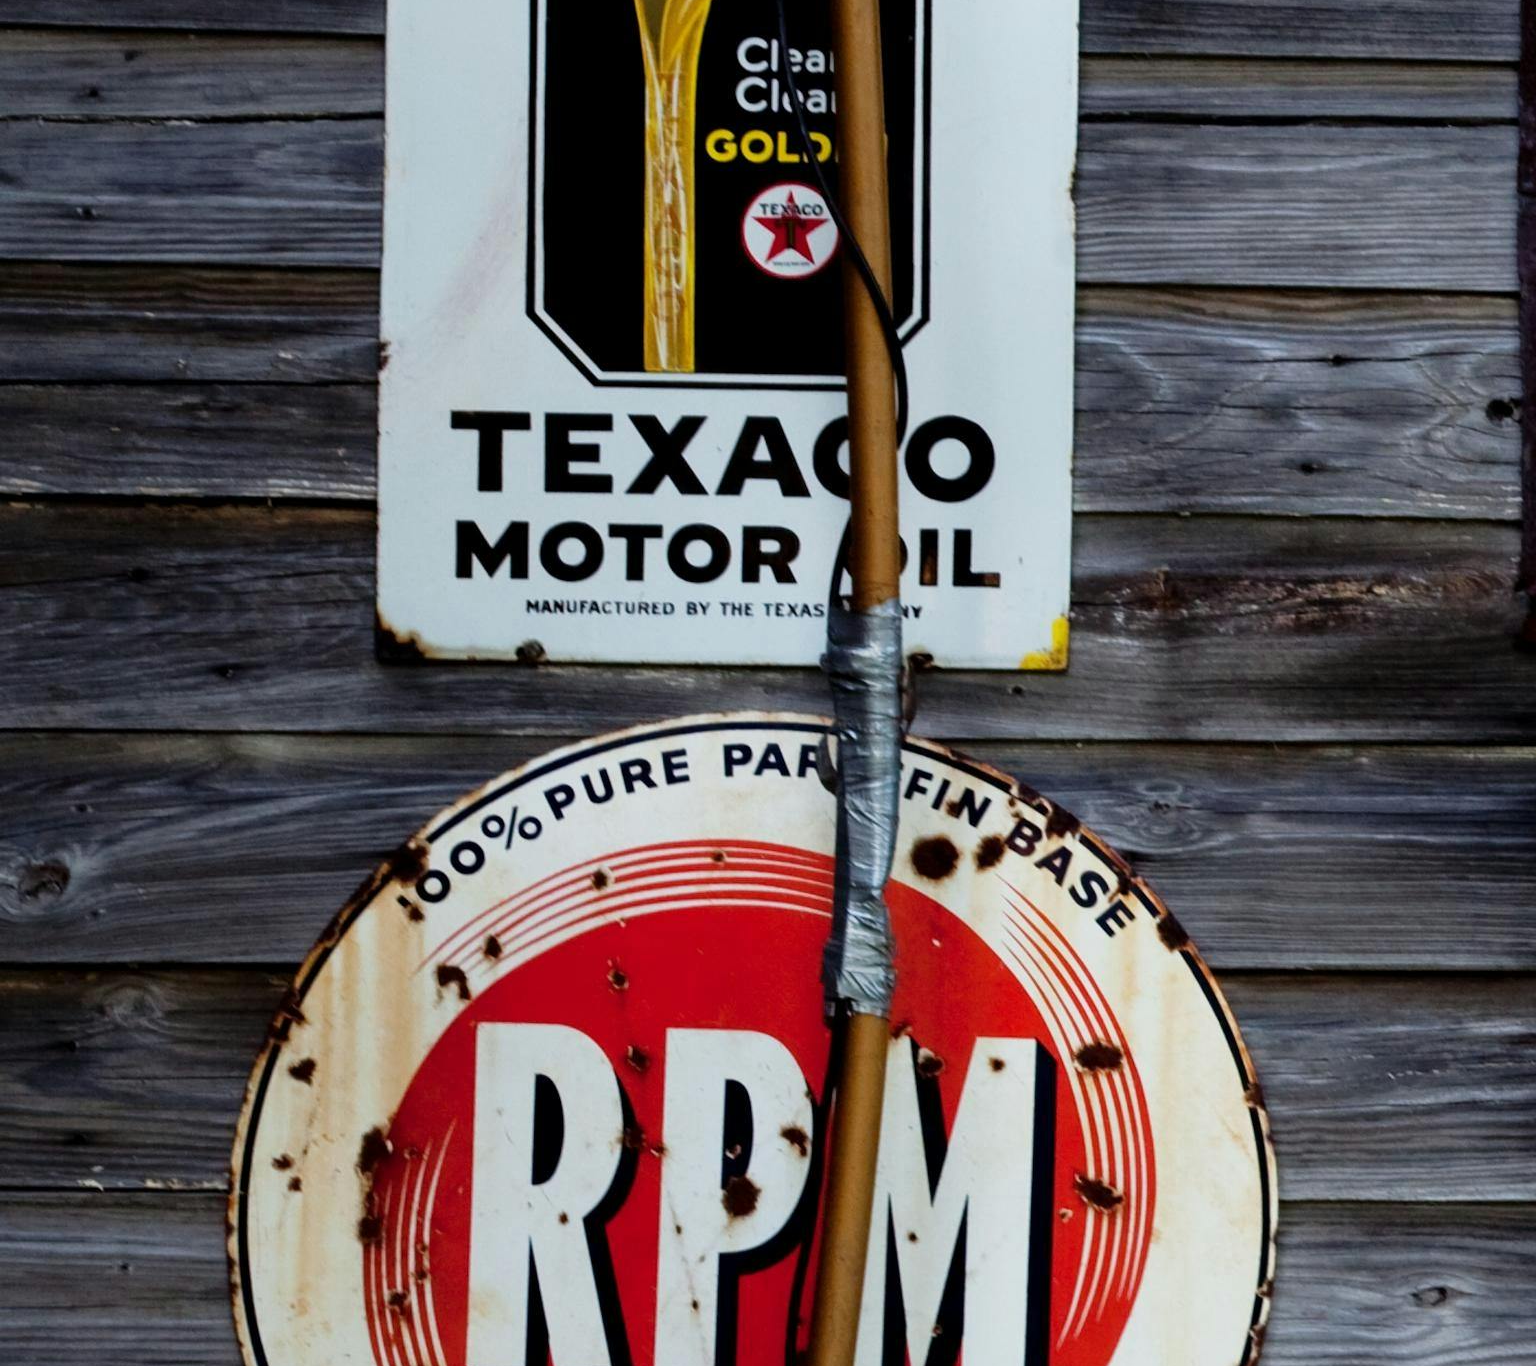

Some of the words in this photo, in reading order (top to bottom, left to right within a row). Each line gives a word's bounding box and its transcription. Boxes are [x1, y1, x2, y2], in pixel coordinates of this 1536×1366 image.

[736, 36, 835, 74] Clea
[735, 76, 837, 115] Clea
[705, 128, 838, 164] GOLD
[759, 202, 824, 216] TEXACO
[454, 519, 798, 585] MOTOR
[843, 527, 1002, 588] IL
[526, 599, 676, 617] MANUFACTURED
[686, 602, 710, 617] BY
[720, 602, 755, 618] THE
[763, 602, 825, 619] TEXAS
[544, 748, 691, 822] PURE
[722, 742, 993, 829] PARFIN
[1003, 819, 1137, 938] BASE
